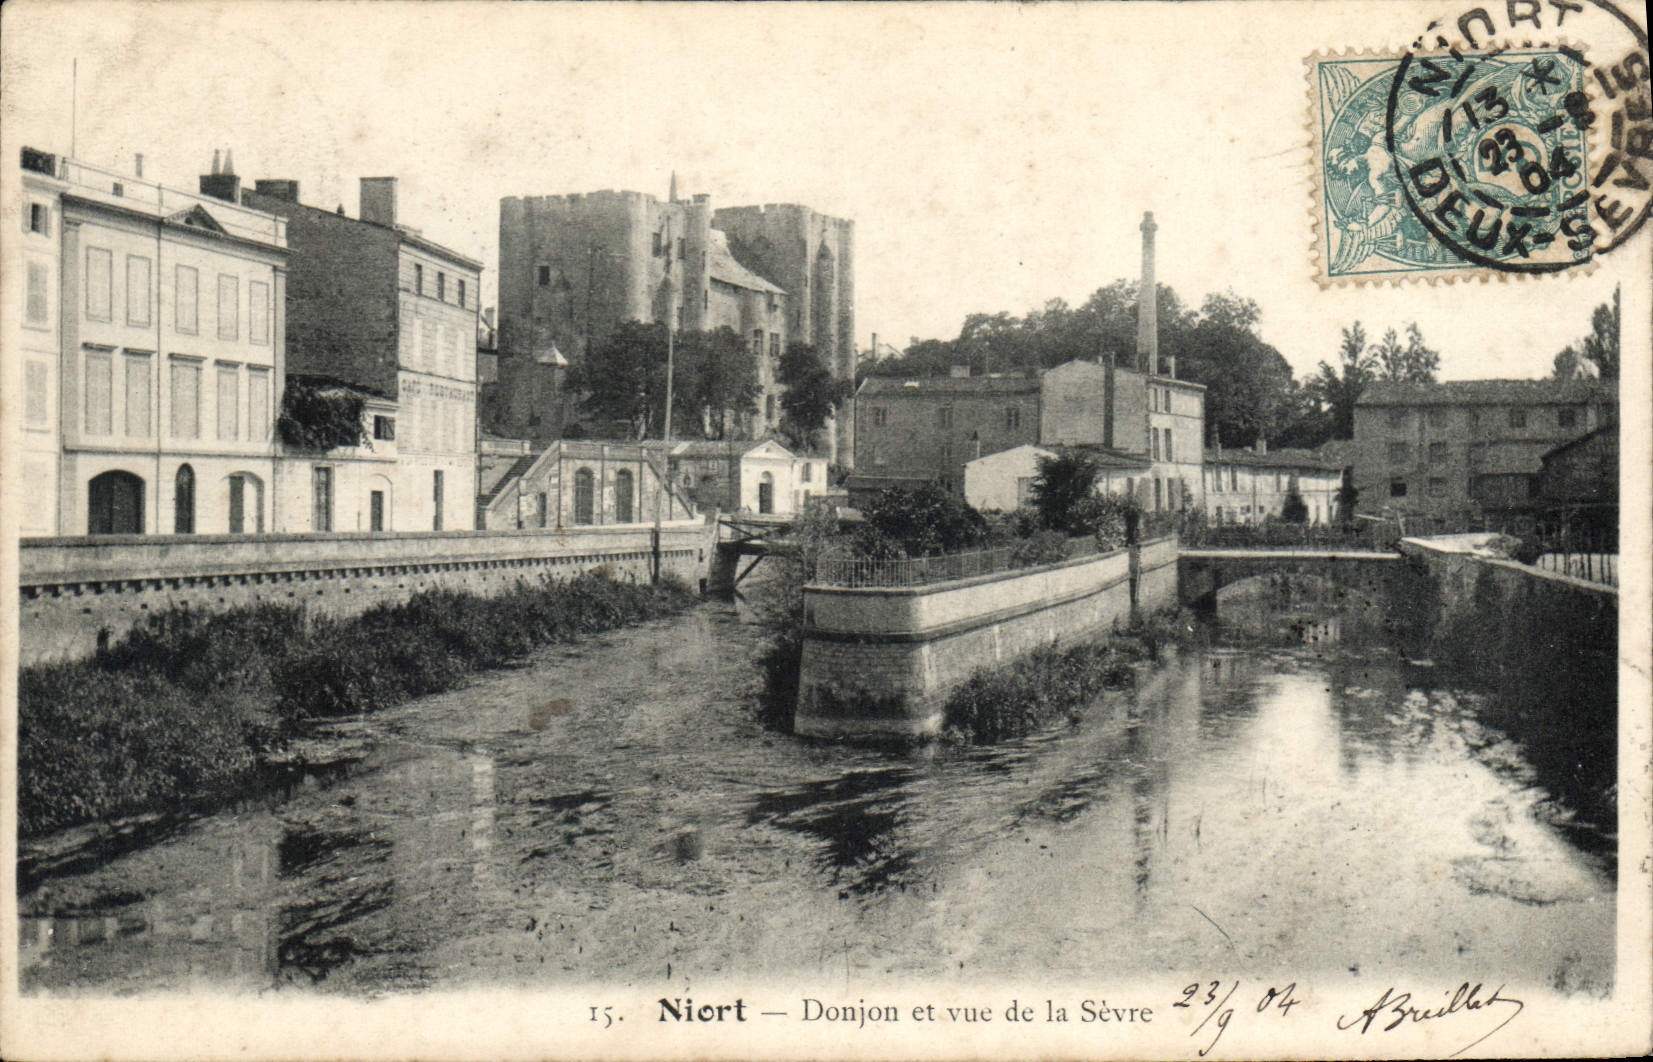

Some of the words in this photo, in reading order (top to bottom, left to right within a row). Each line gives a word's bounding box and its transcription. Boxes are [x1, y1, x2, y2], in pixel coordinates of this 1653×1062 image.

[1478, 128, 1524, 176] 23
[1561, 113, 1583, 207] POSTE
[589, 999, 624, 1028] 15.
[658, 998, 747, 1023] Niort
[802, 998, 899, 1028] Donjon
[912, 1003, 936, 1022] et
[947, 1006, 993, 1022] vue
[1005, 998, 1035, 1022] de
[1047, 998, 1069, 1022] la
[1081, 998, 1154, 1023] Sèvre
